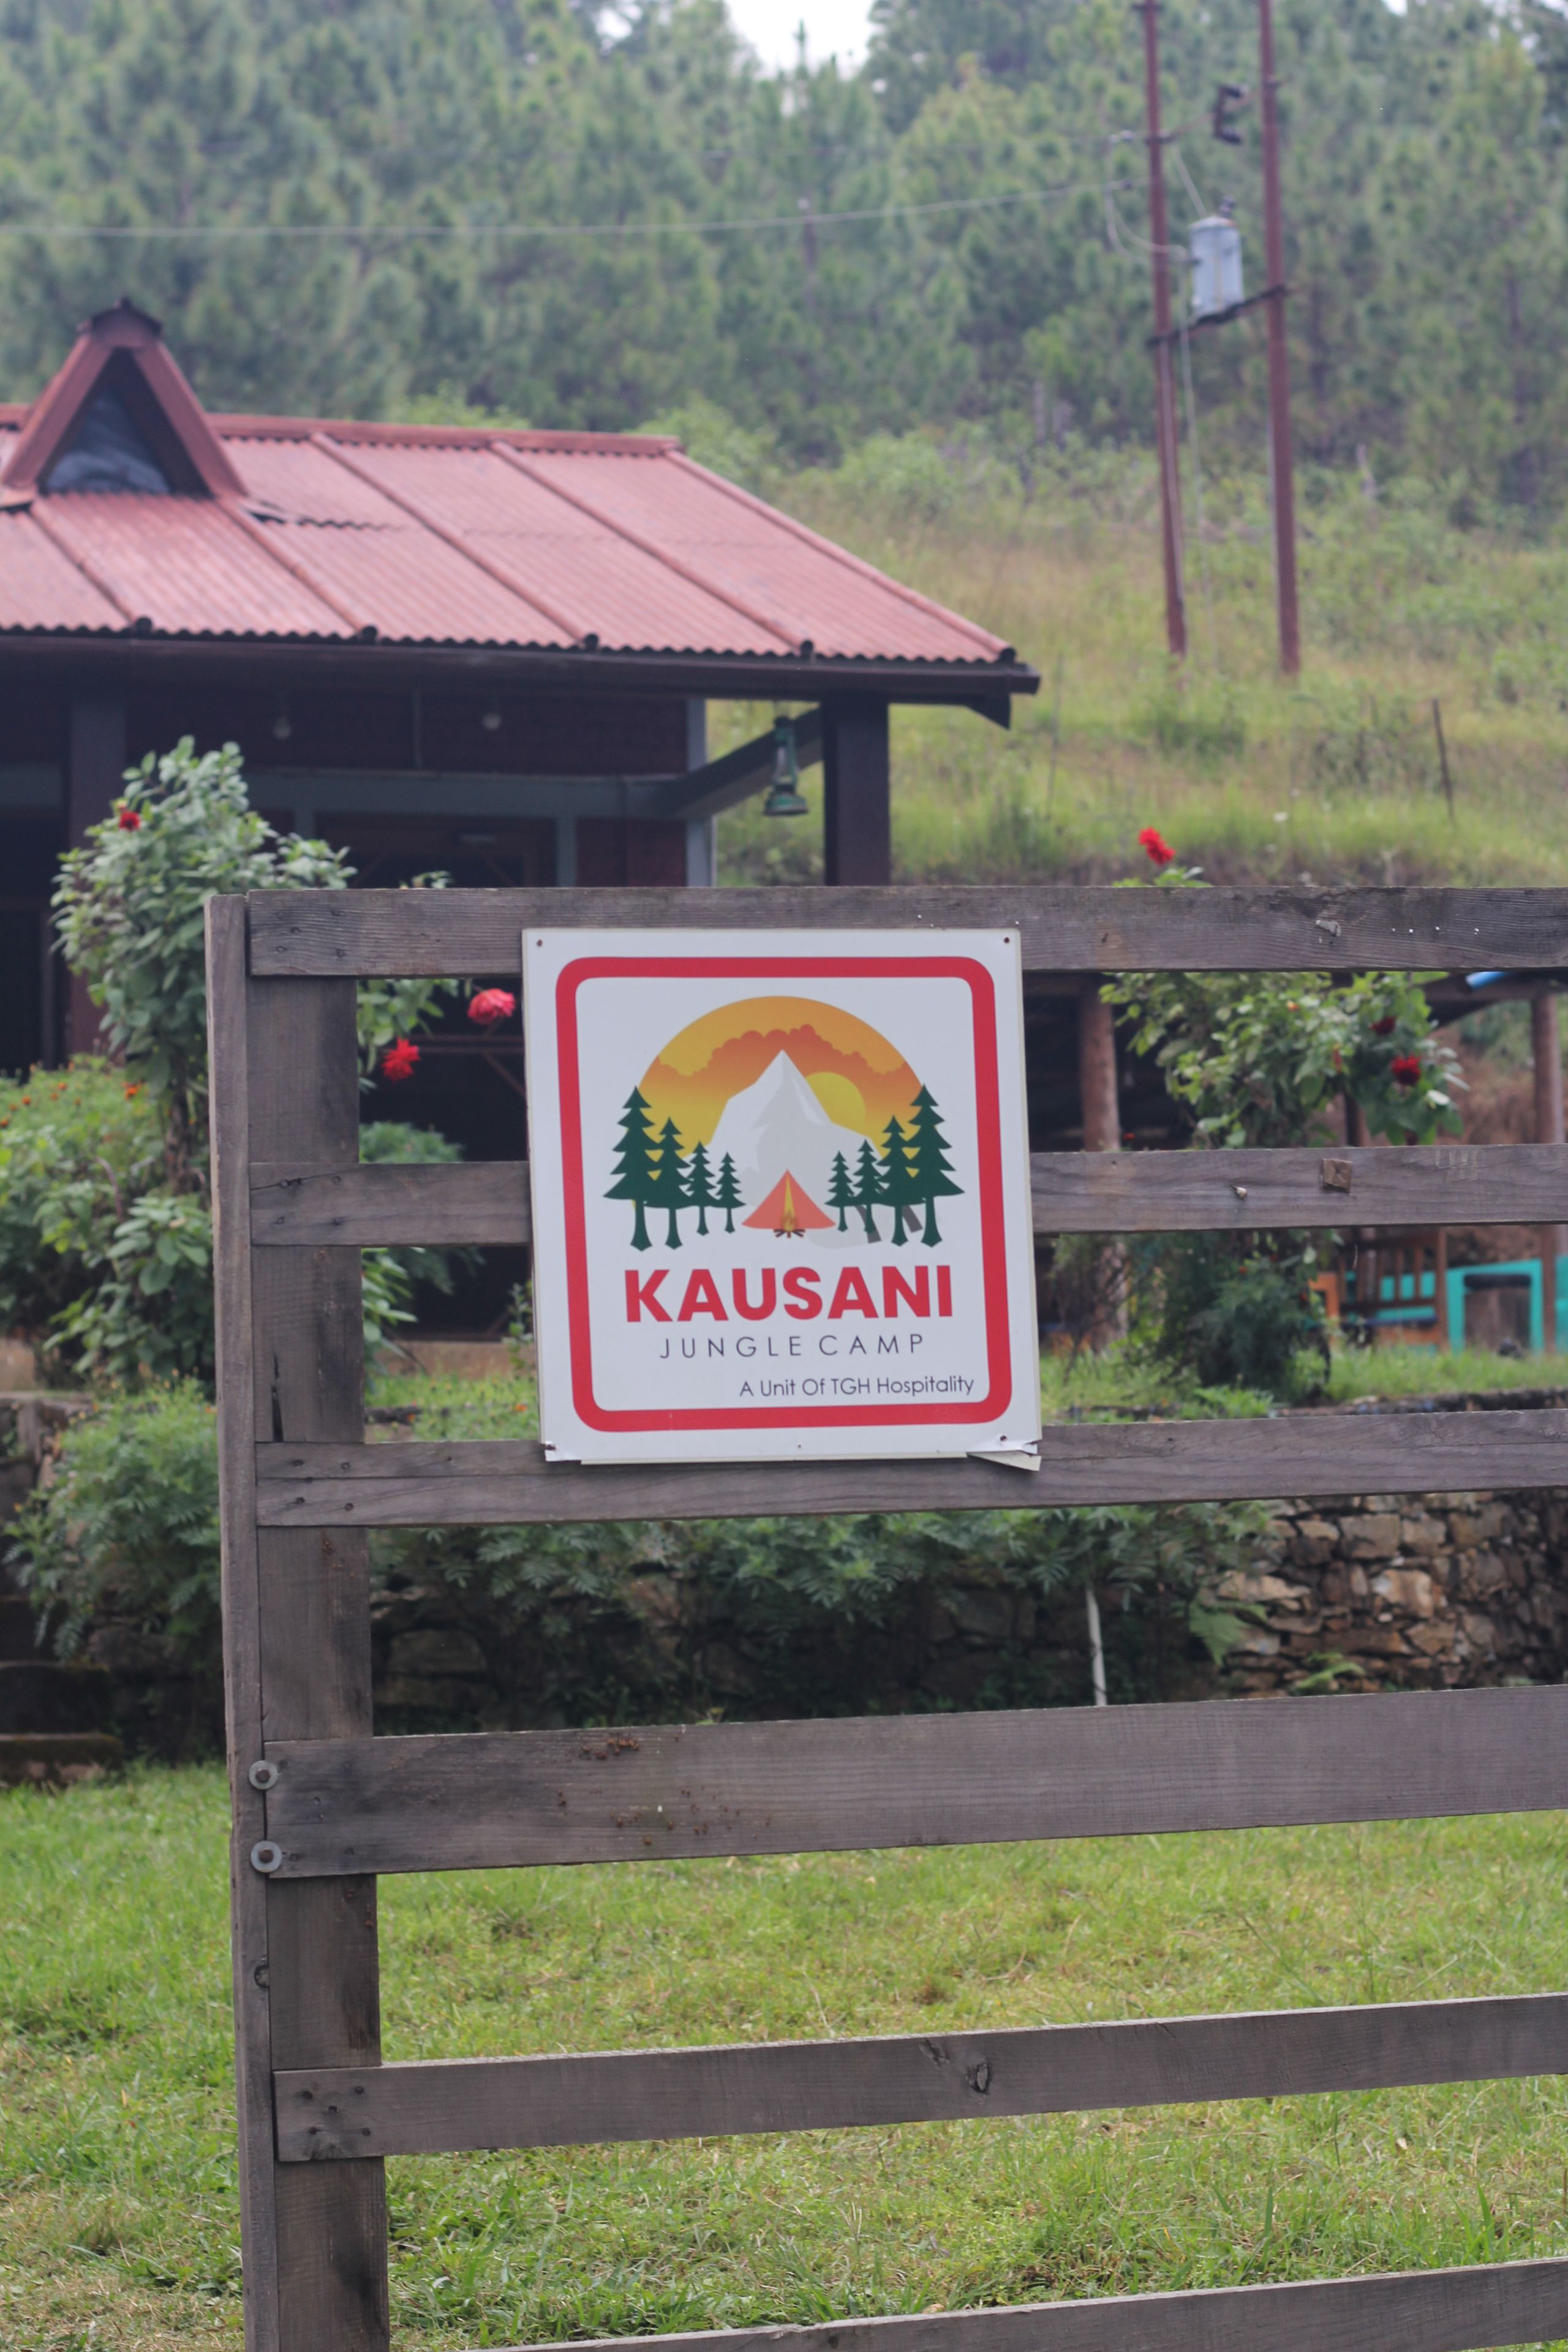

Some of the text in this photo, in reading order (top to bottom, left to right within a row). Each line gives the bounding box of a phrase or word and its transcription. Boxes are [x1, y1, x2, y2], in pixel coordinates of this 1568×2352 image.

[624, 1265, 953, 1323] KAUSANI
[660, 1333, 923, 1359] JUNGLE CAMP
[739, 1375, 974, 1397] A Unit Of TGH Hospitality
